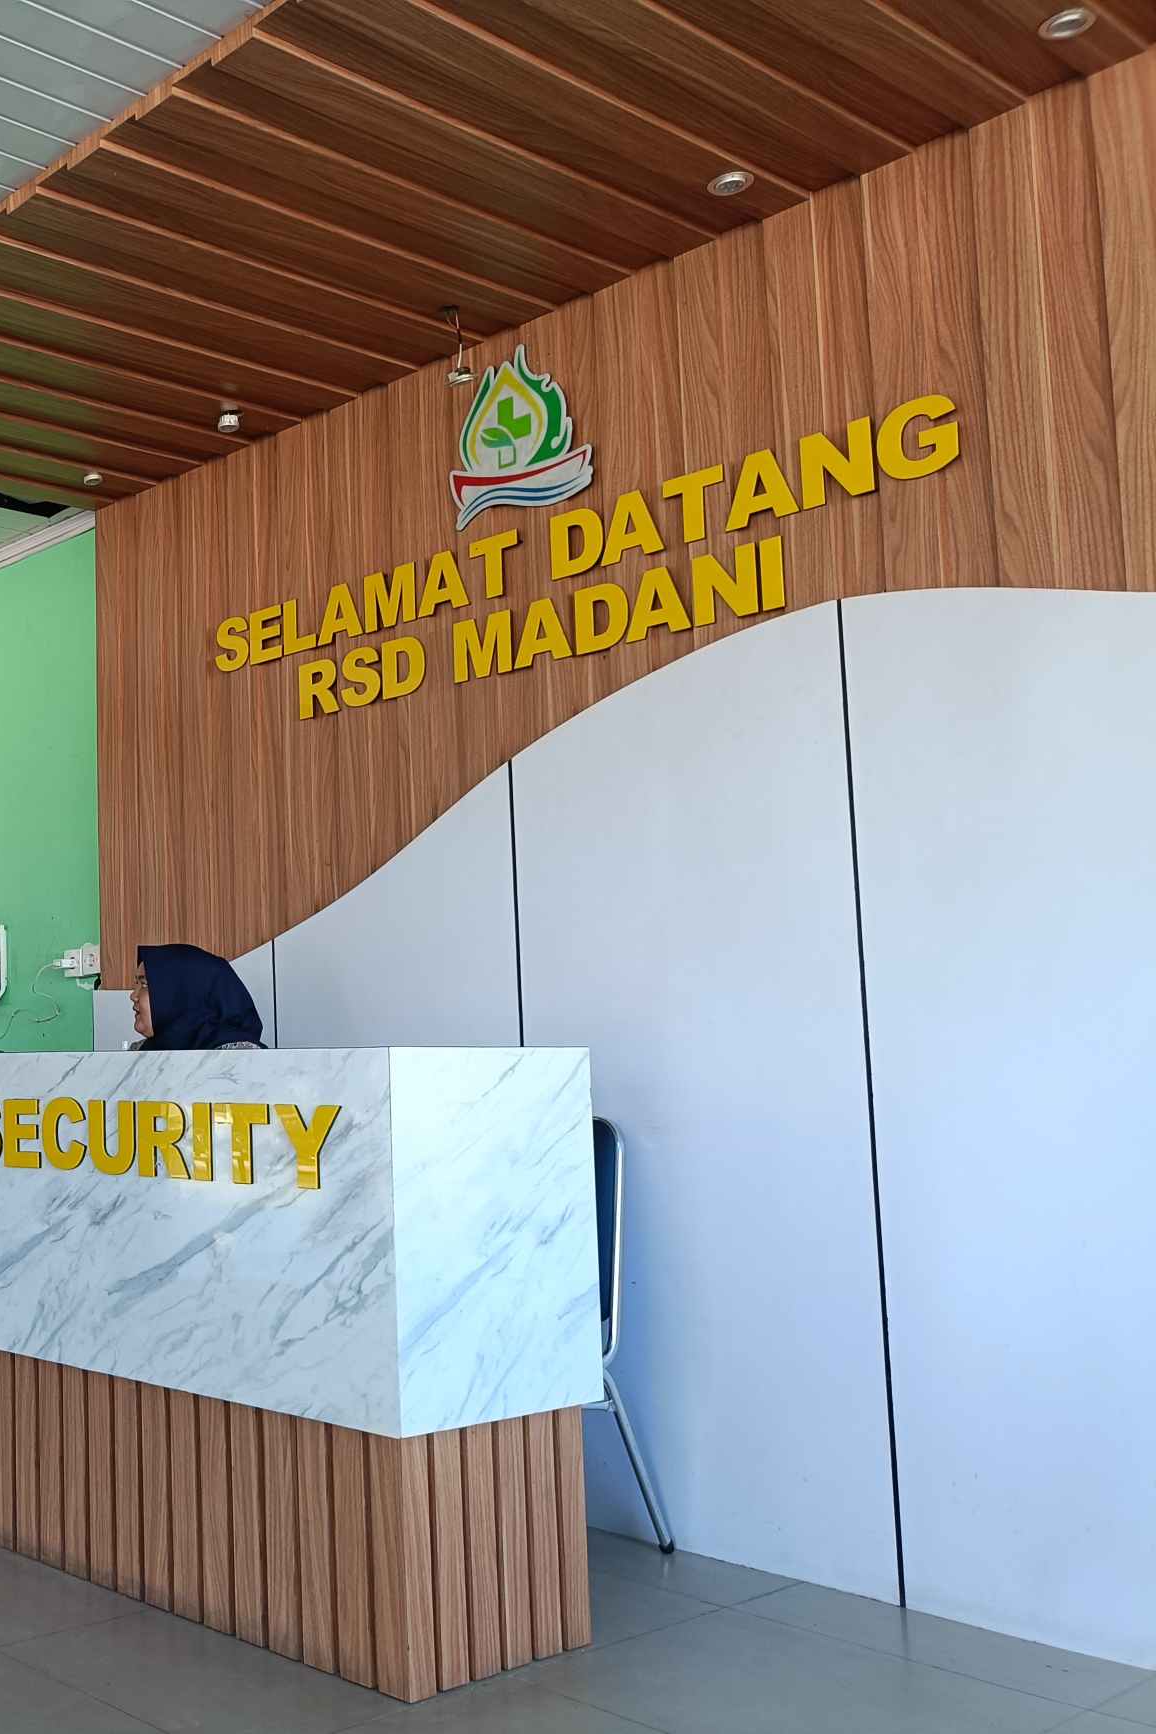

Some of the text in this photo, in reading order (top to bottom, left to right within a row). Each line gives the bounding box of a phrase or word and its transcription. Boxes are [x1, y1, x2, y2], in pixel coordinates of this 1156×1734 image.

[215, 394, 961, 673] SELAMAT DATANG
[298, 535, 788, 721] RSD MADANI
